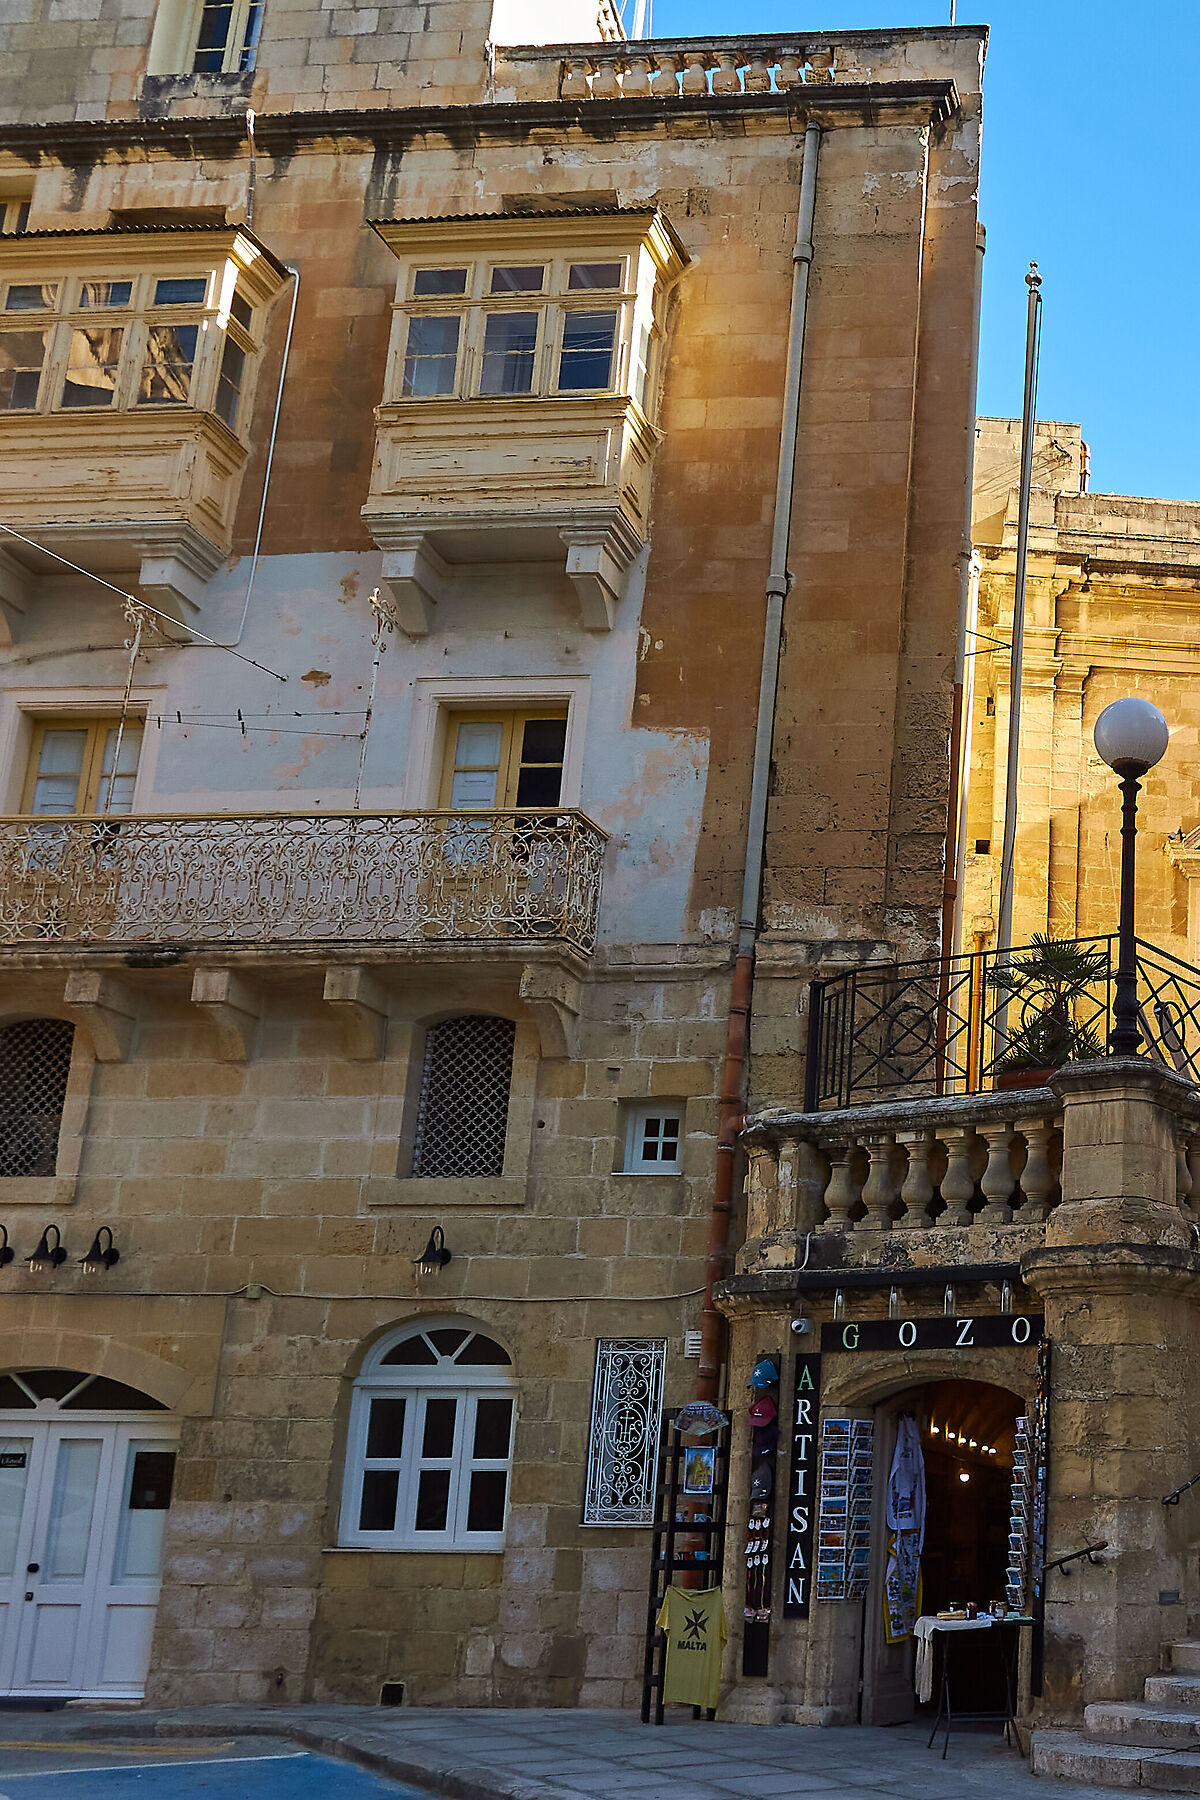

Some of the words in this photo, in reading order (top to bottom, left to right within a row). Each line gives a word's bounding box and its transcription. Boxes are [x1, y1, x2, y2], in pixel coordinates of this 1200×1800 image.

[842, 1317, 1031, 1349] GOZO
[786, 1364, 815, 1604] ARTISAN
[677, 1640, 707, 1651] MALTA
